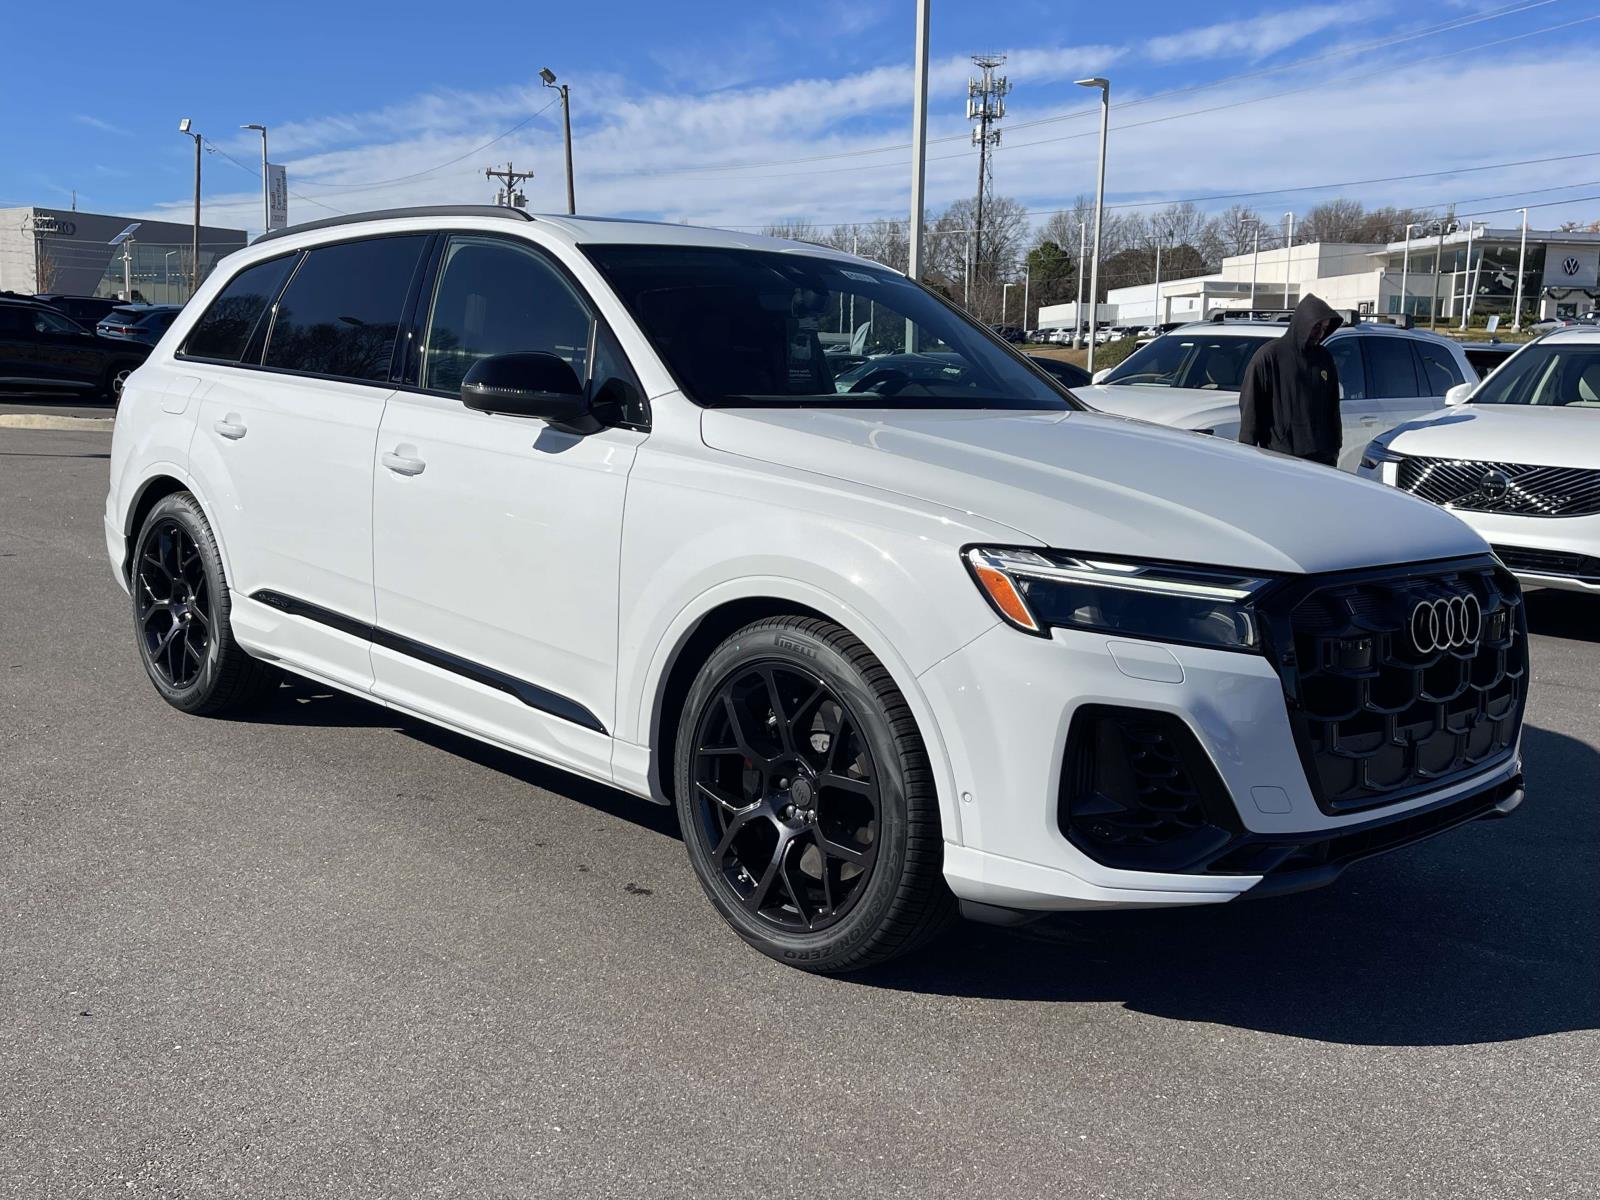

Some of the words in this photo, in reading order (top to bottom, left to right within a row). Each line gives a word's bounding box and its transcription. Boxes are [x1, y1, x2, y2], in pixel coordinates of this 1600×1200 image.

[774, 632, 819, 659] PIRELLI
[839, 850, 900, 952] SCORPION
[784, 945, 834, 961] ZERO
